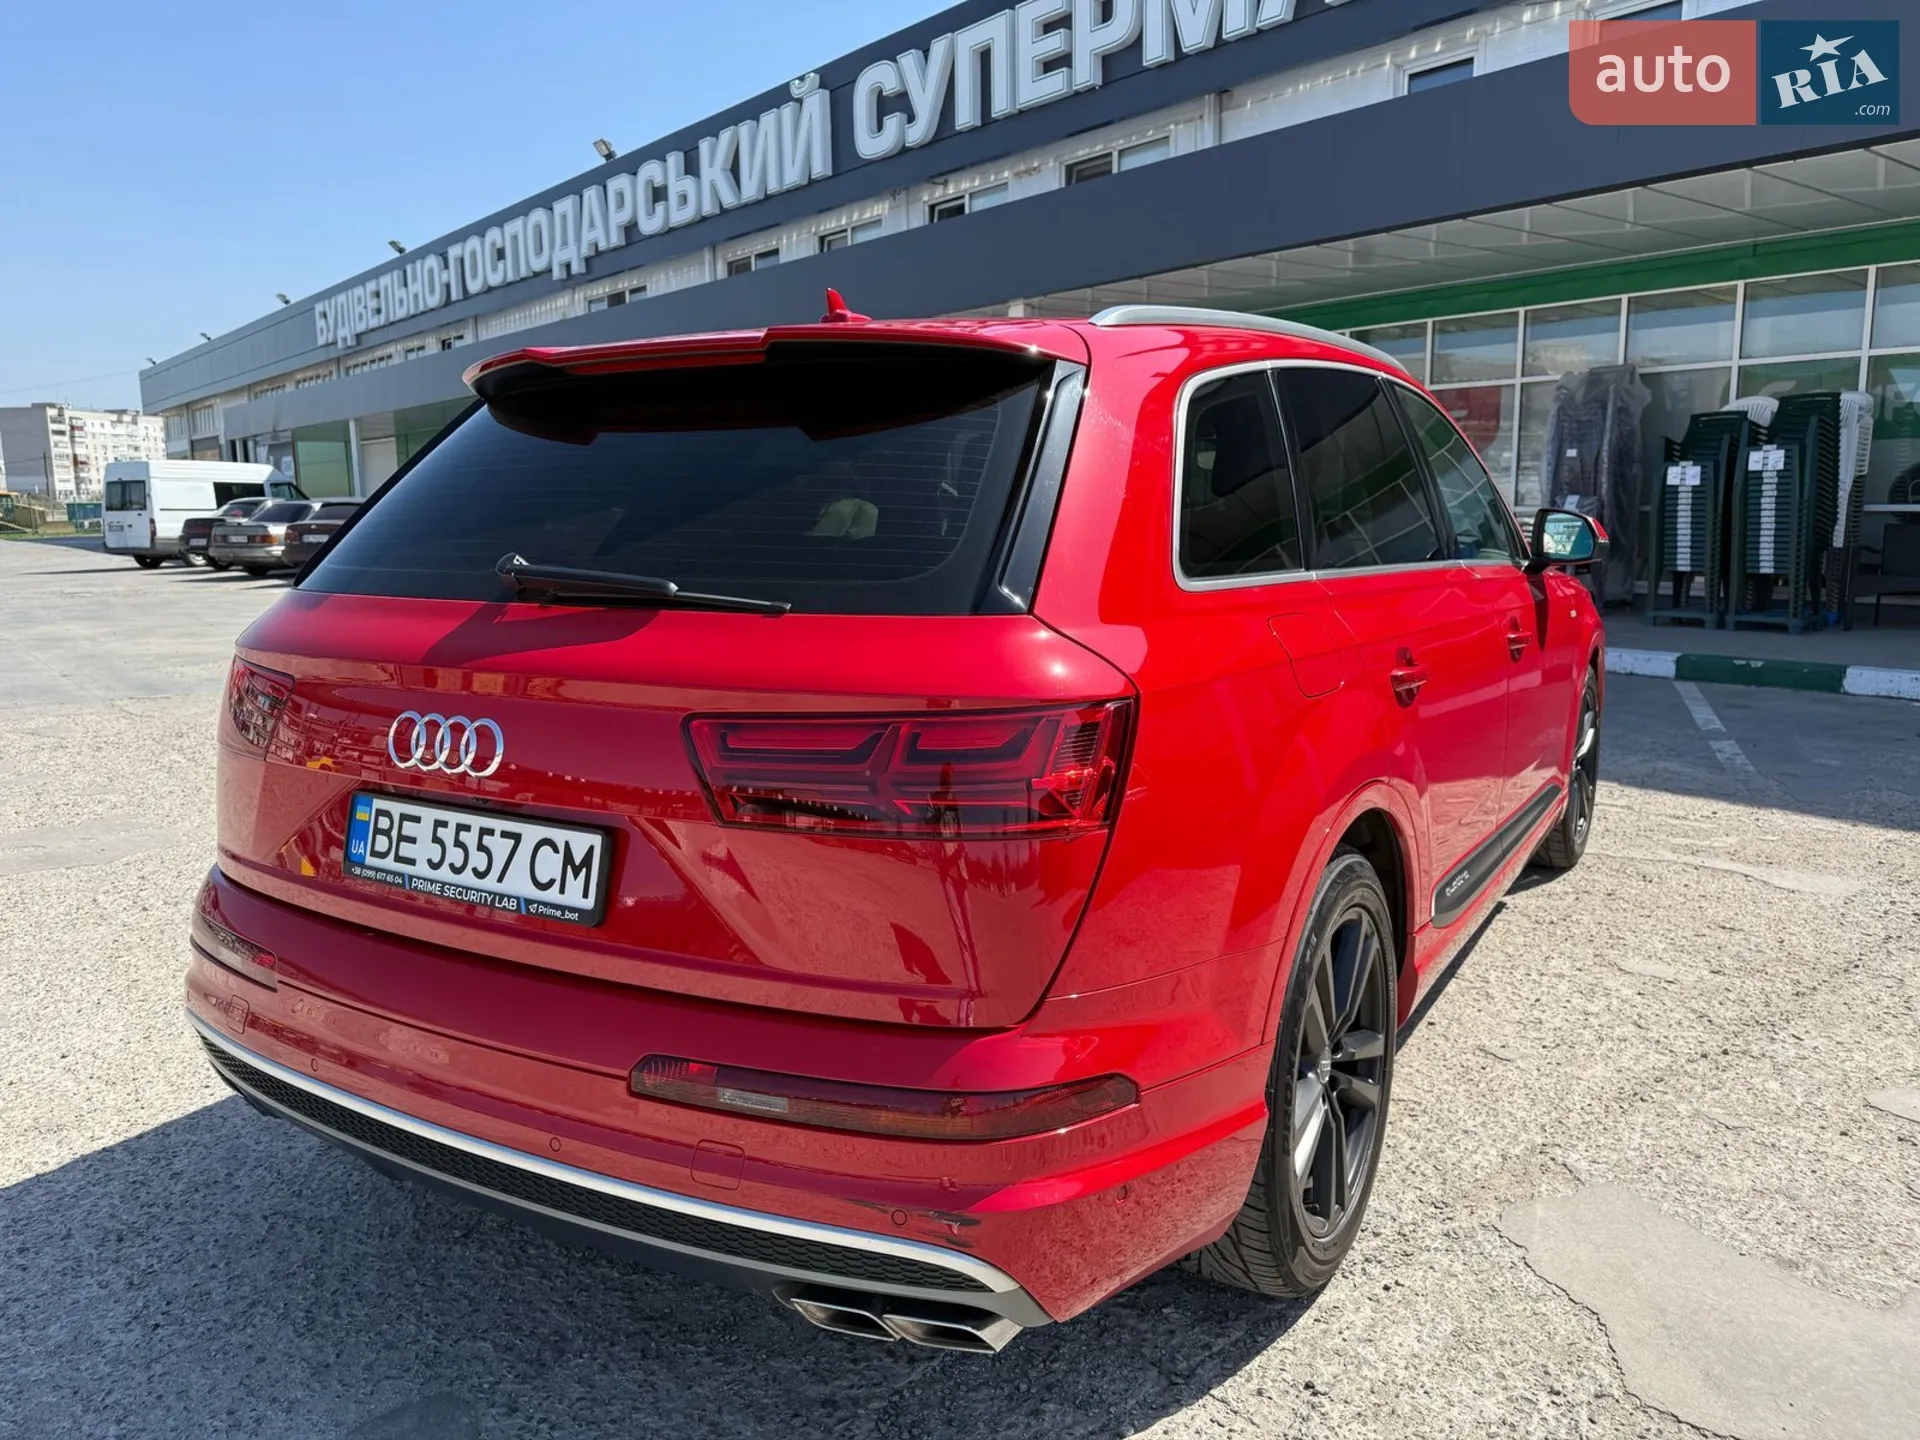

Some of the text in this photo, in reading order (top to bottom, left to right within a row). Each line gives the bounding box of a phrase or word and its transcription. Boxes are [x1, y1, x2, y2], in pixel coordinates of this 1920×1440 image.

[314, 72, 833, 348] БУДІВЕЛЬНО-ГОСПОДАРСЬКИЙ
[351, 838, 365, 856] UA
[369, 807, 594, 899] BE 5557 CM
[411, 877, 517, 910] PRIME SECURITY LAB
[538, 904, 579, 920] Prime_bot
